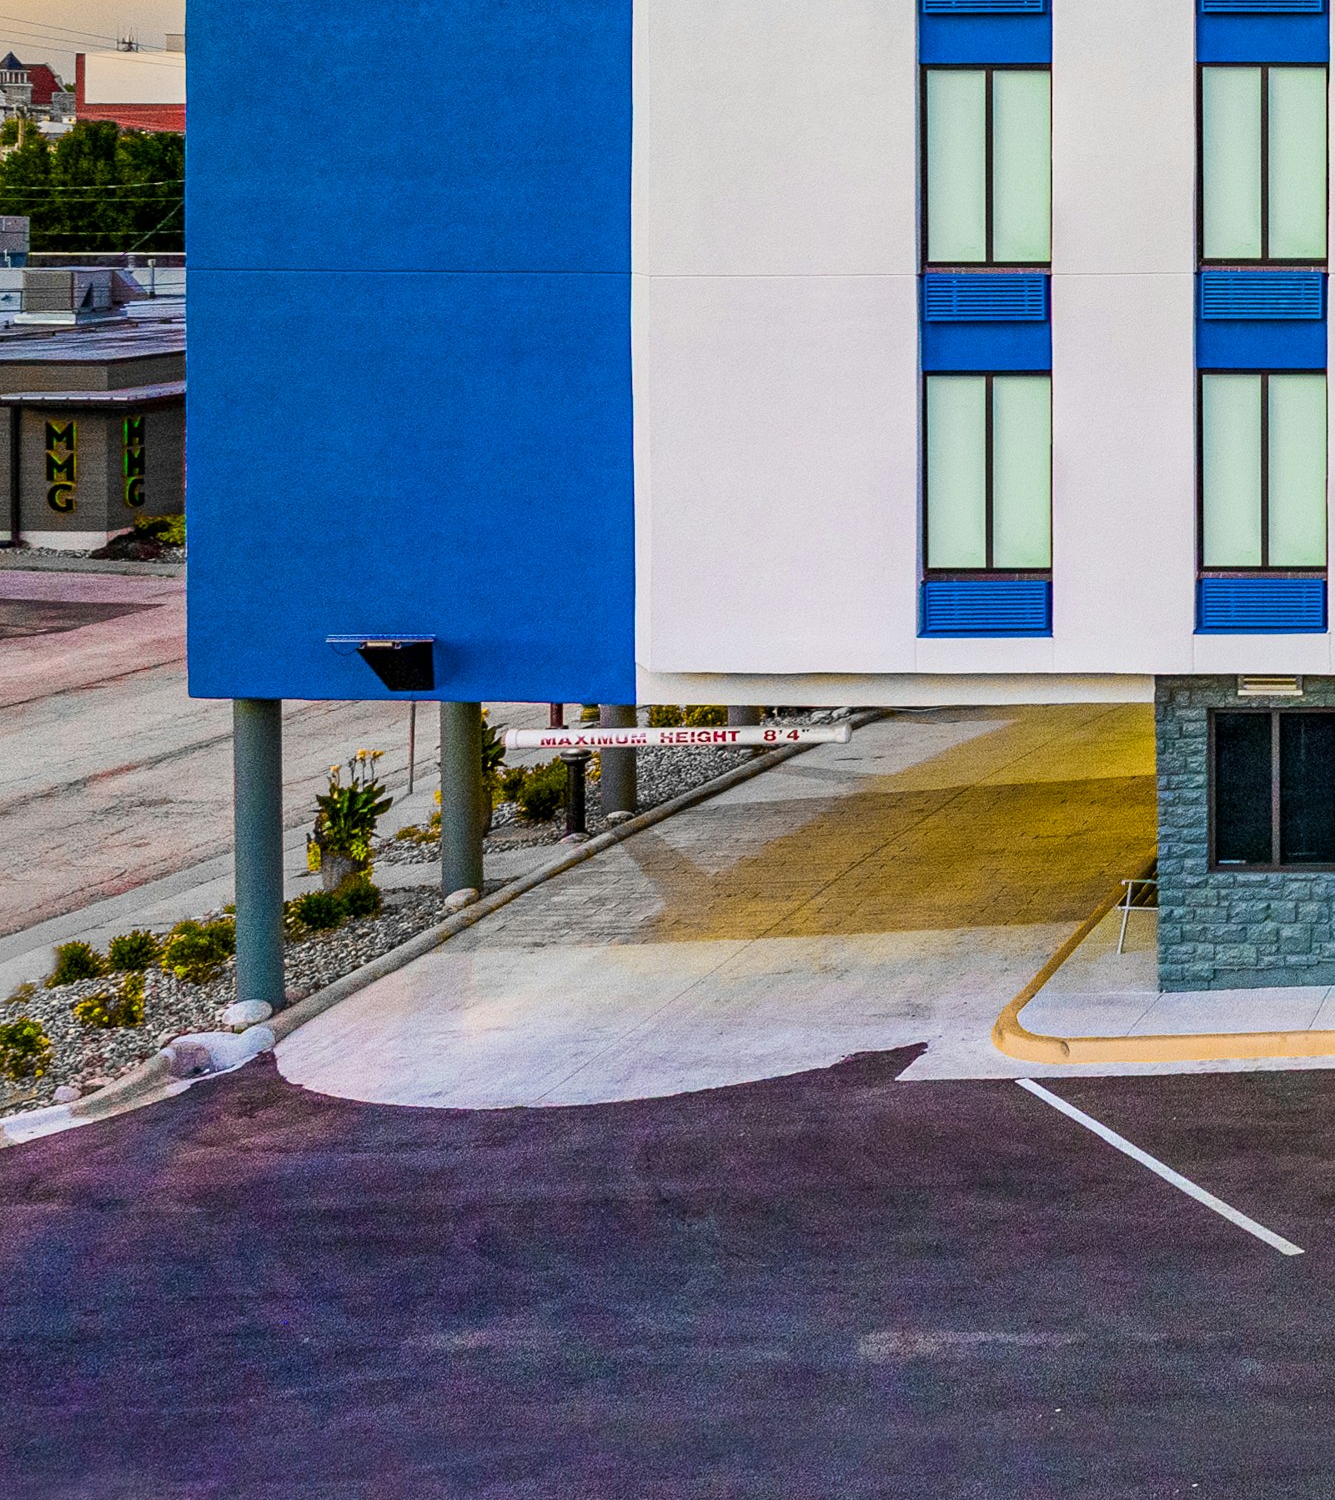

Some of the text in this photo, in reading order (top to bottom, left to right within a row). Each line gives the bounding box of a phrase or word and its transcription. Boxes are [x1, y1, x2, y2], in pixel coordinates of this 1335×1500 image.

[46, 419, 77, 513] MMG
[540, 728, 811, 746] MAXIMUM HEIGHT 8'4"
